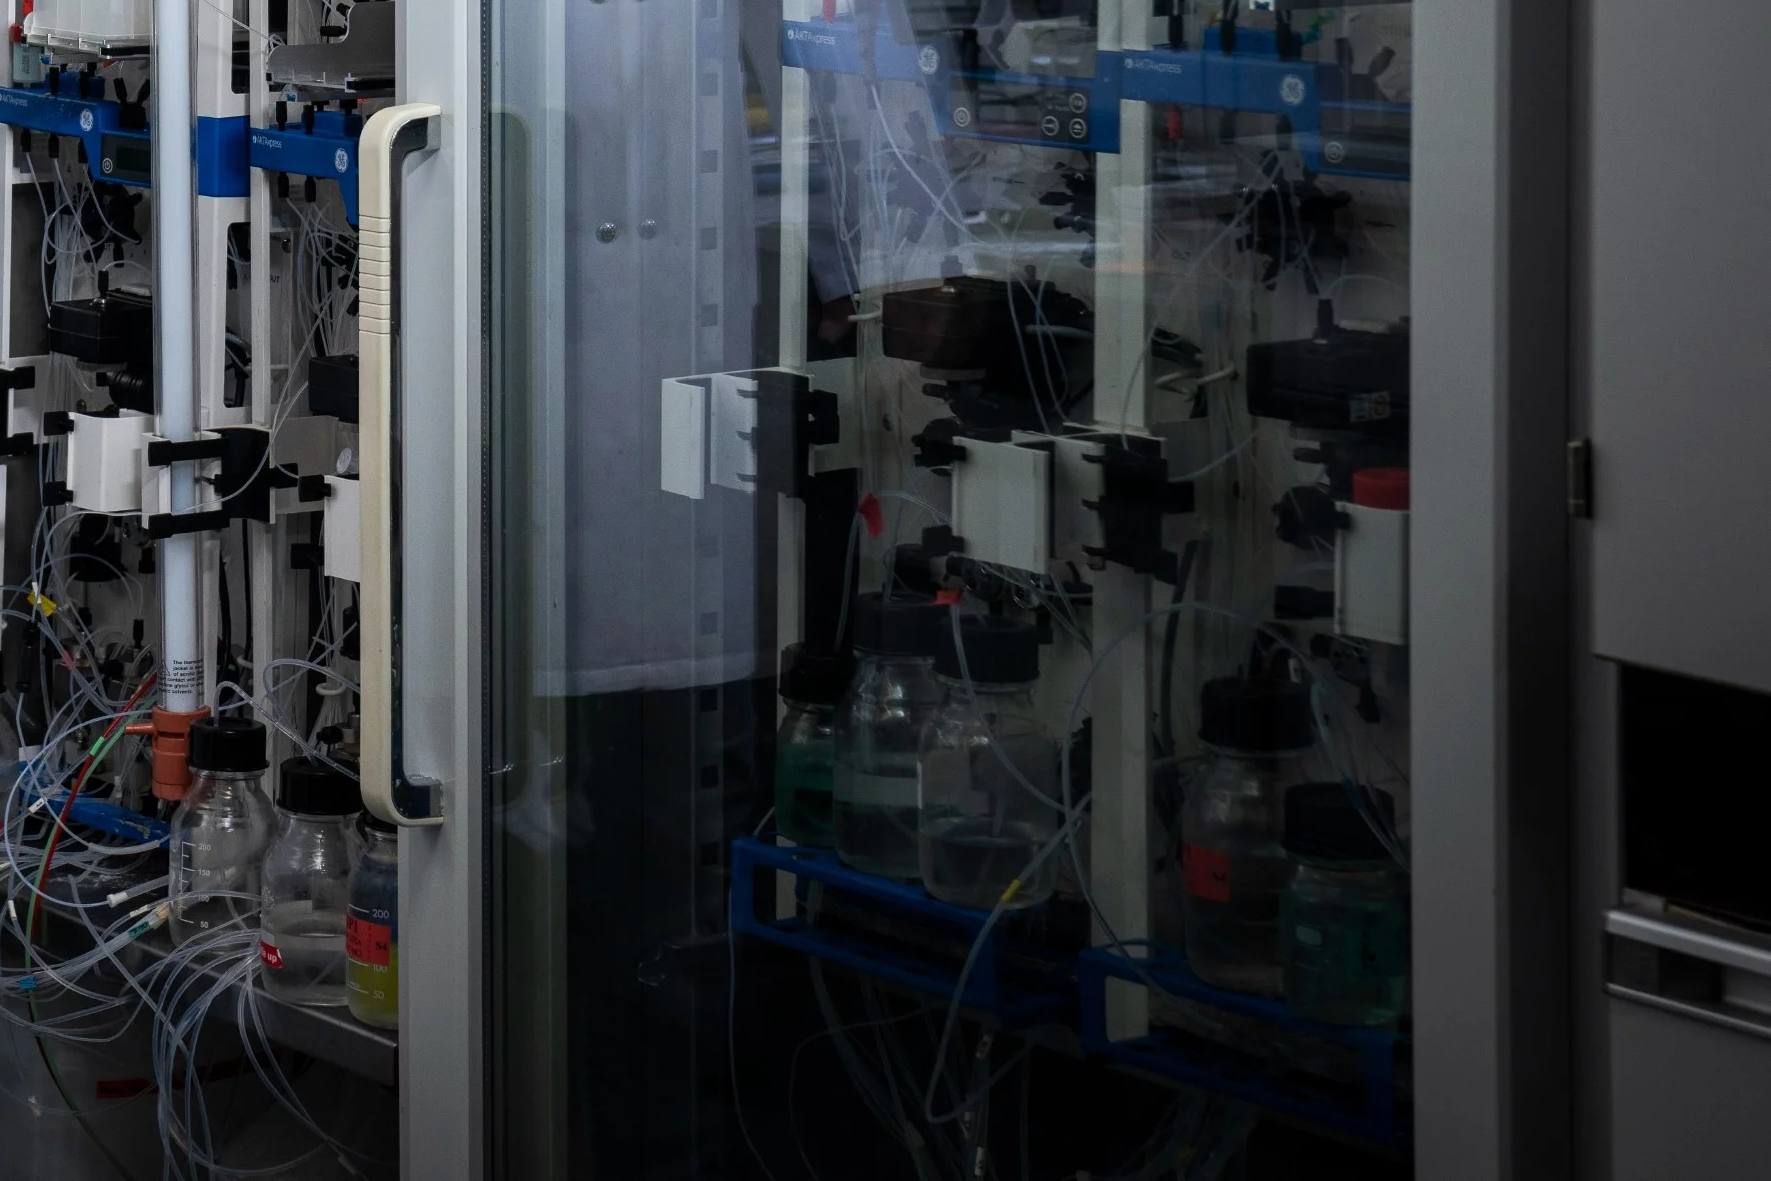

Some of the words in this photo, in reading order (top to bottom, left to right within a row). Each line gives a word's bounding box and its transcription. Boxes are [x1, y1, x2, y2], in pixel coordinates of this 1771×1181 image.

[198, 843, 212, 852] 200
[198, 869, 211, 877] 150
[372, 908, 390, 919] 200
[200, 921, 209, 929] 50
[372, 990, 385, 999] 50
